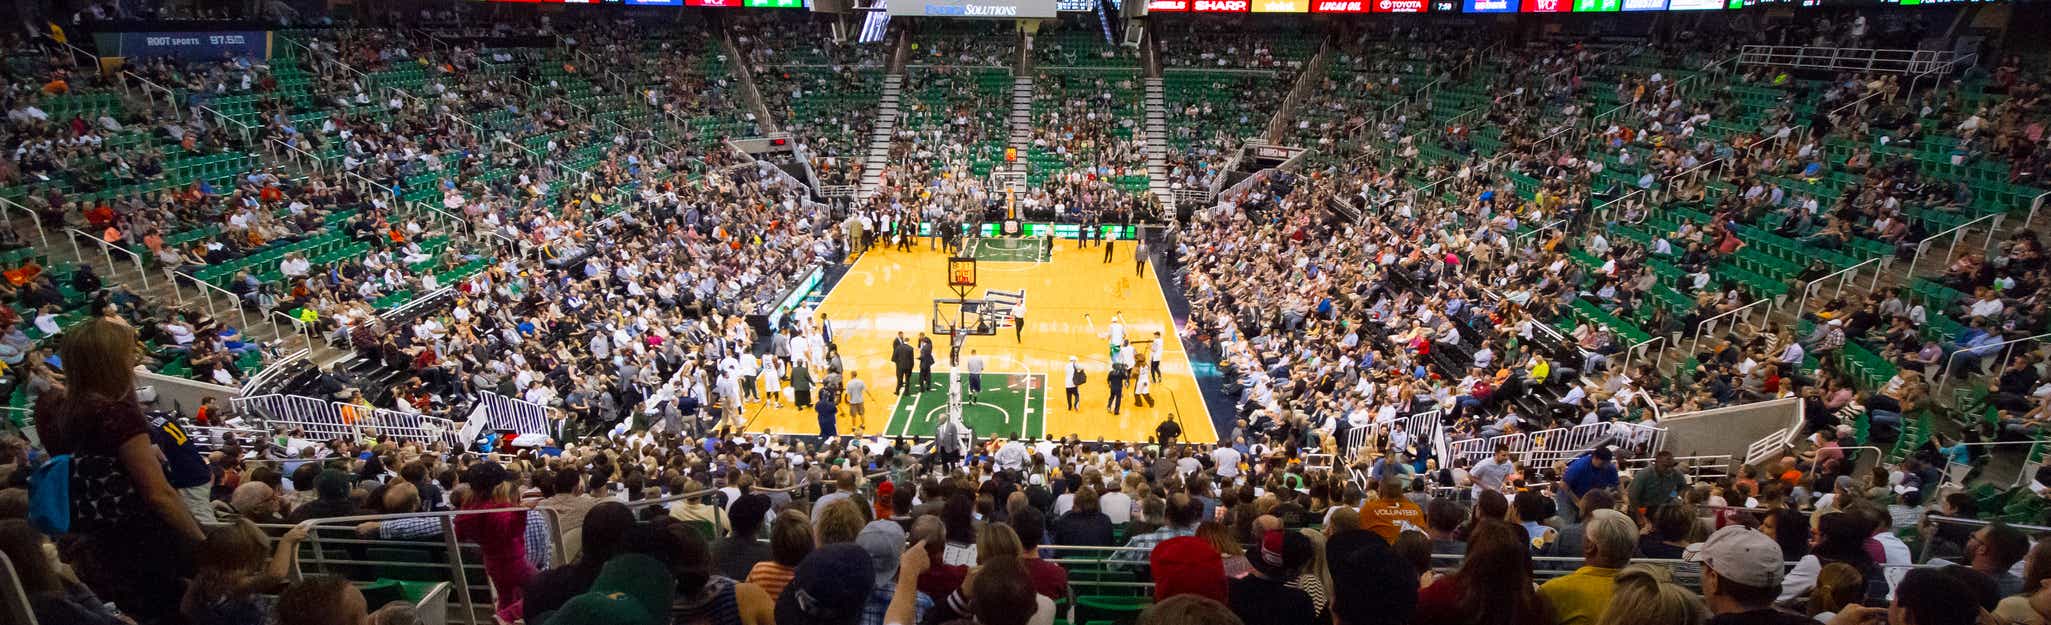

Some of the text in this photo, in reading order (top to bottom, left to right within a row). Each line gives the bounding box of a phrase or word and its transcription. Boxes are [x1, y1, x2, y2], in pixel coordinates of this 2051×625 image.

[1194, 1, 1246, 11] SHARP
[1319, 1, 1361, 10] LUCAS OIL
[146, 36, 171, 46] ROOT
[172, 37, 200, 46] SPORTS
